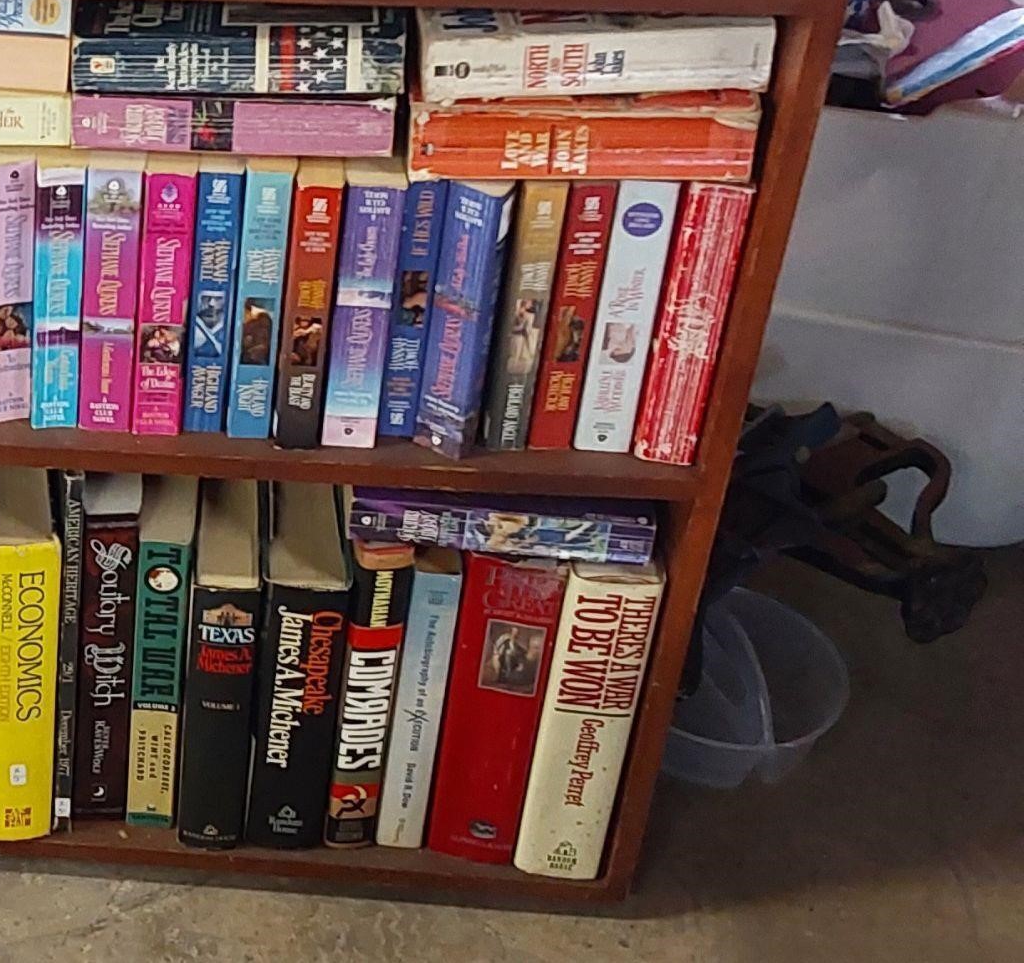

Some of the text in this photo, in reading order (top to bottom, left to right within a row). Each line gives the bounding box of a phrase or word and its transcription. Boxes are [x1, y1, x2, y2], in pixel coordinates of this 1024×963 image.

[527, 44, 551, 88] NORTH
[561, 43, 584, 87] SOUTH
[587, 51, 609, 76] John
[501, 130, 520, 170] LOVE
[155, 238, 181, 285] STEPHANIE
[199, 241, 214, 282] HOWELL
[213, 239, 231, 283] HANNAH
[246, 249, 262, 282] HOWELL
[263, 249, 282, 284] HANNAH
[191, 365, 205, 408] AVENGER
[204, 365, 222, 414] HIGHLAND
[65, 499, 84, 563] AMERICAN
[61, 564, 80, 625] HERITAGE
[370, 571, 394, 628] MOYNAHAN
[83, 539, 132, 708] Solitary Witch
[198, 624, 255, 644] TEXAS
[15, 570, 45, 722] ECONOMICS
[303, 610, 343, 716] Chesapeake
[557, 594, 623, 709] TO BE WON
[139, 644, 178, 700] WAR
[266, 604, 314, 769] James A. Michener
[611, 664, 641, 680] A
[601, 678, 638, 711] WAR
[57, 710, 73, 756] December
[151, 735, 161, 759] WINT
[57, 757, 70, 777] 1977
[406, 763, 417, 784] David
[564, 718, 605, 807] Geoffrey Perret
